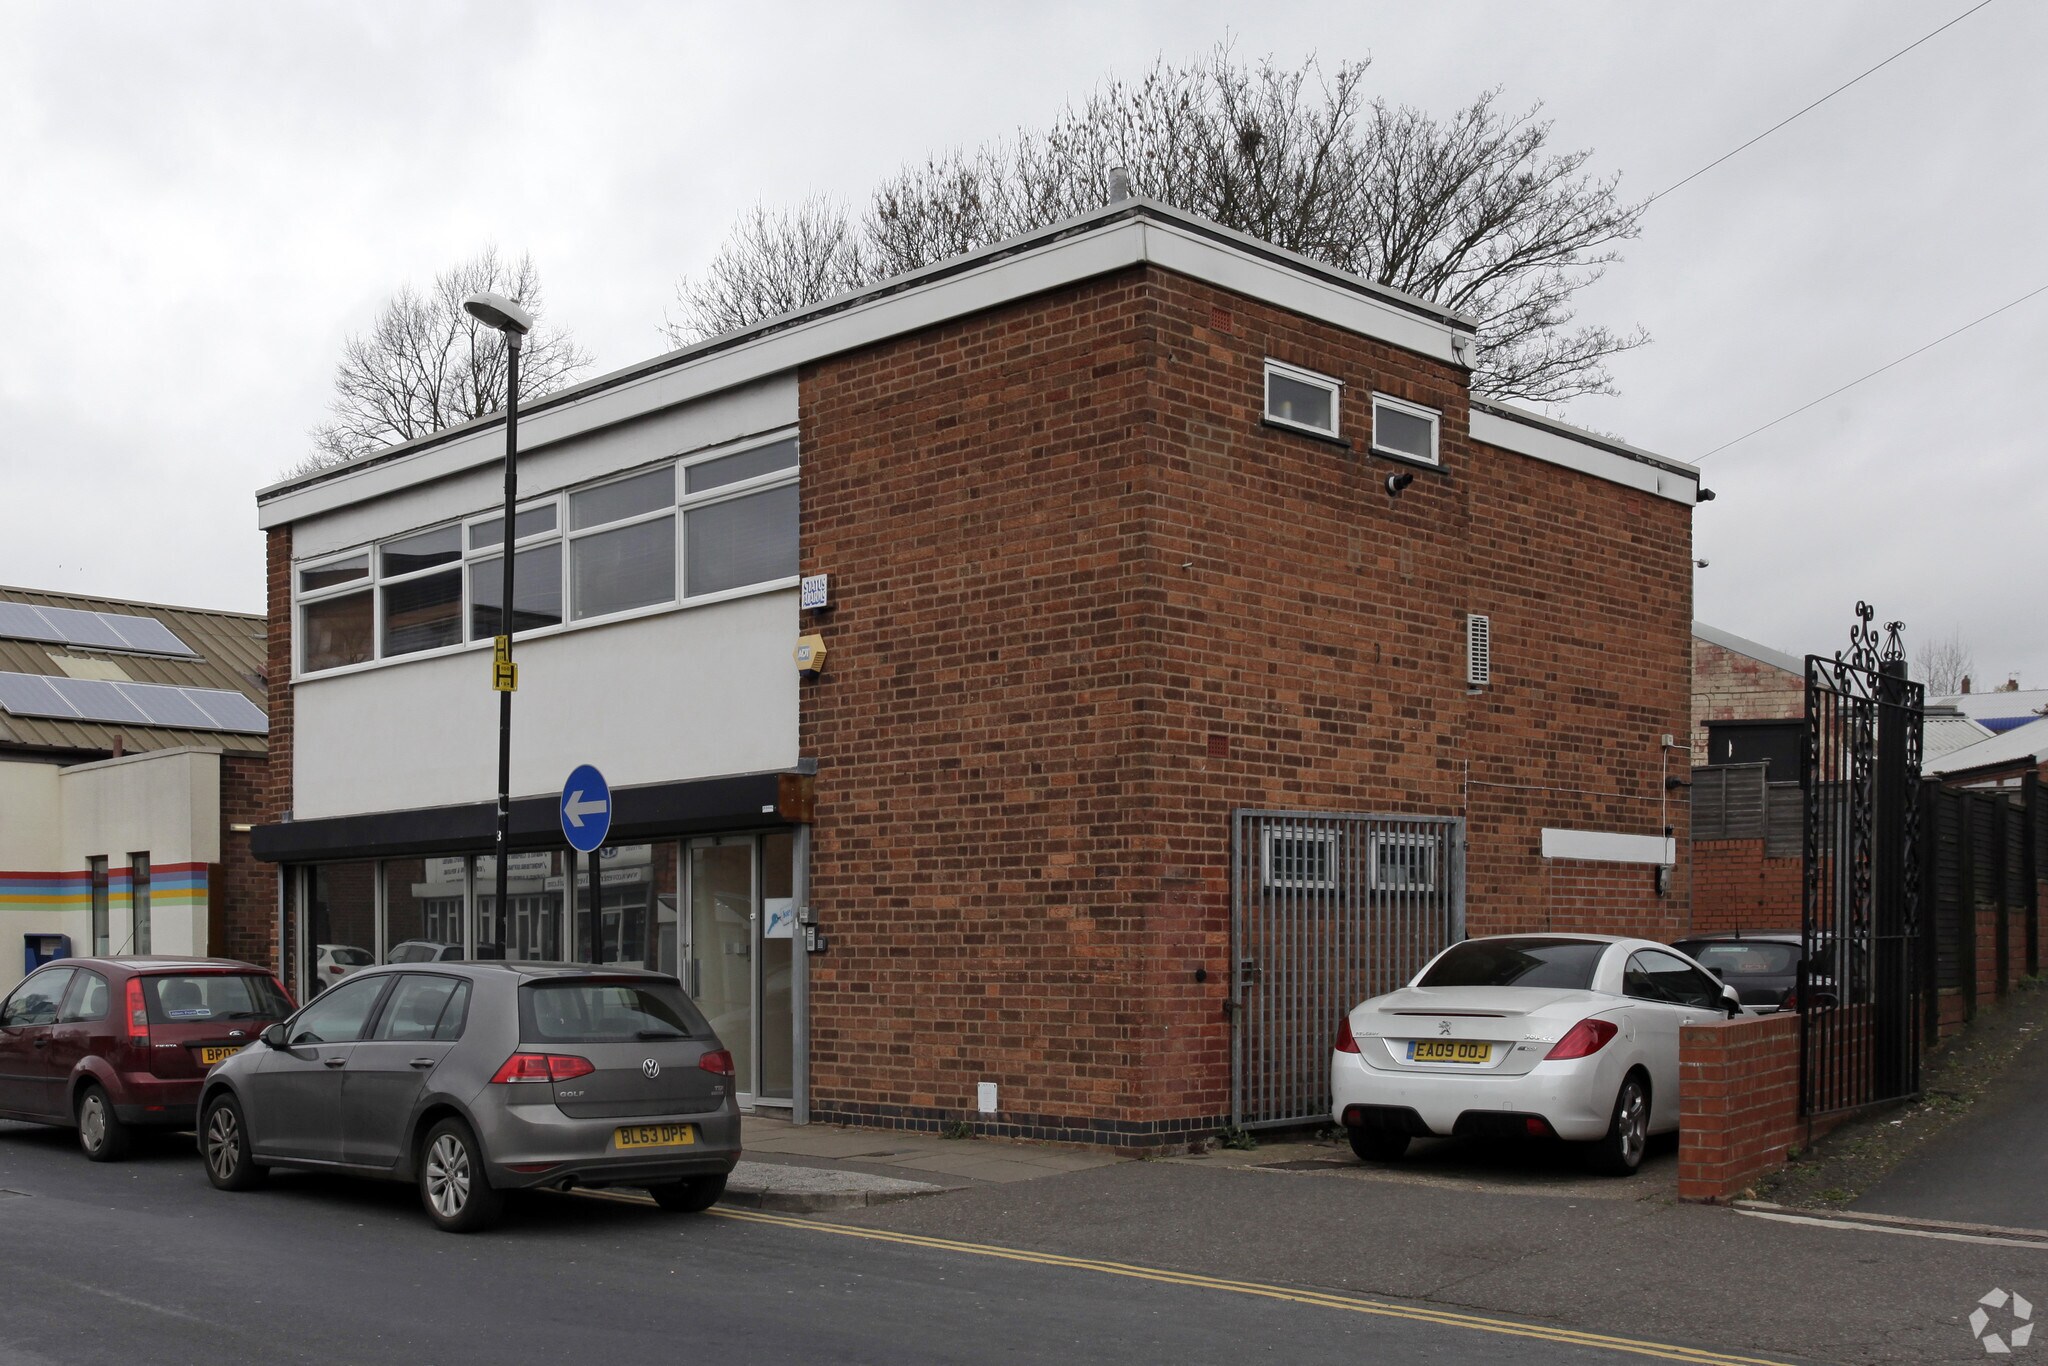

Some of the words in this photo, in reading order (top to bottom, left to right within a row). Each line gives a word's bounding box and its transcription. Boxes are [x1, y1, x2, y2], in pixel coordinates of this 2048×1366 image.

[496, 665, 514, 688] H
[1416, 1042, 1454, 1058] EA09
[559, 1090, 585, 1098] GOLF
[621, 1127, 658, 1145] BL63
[662, 1126, 687, 1143] DPF
